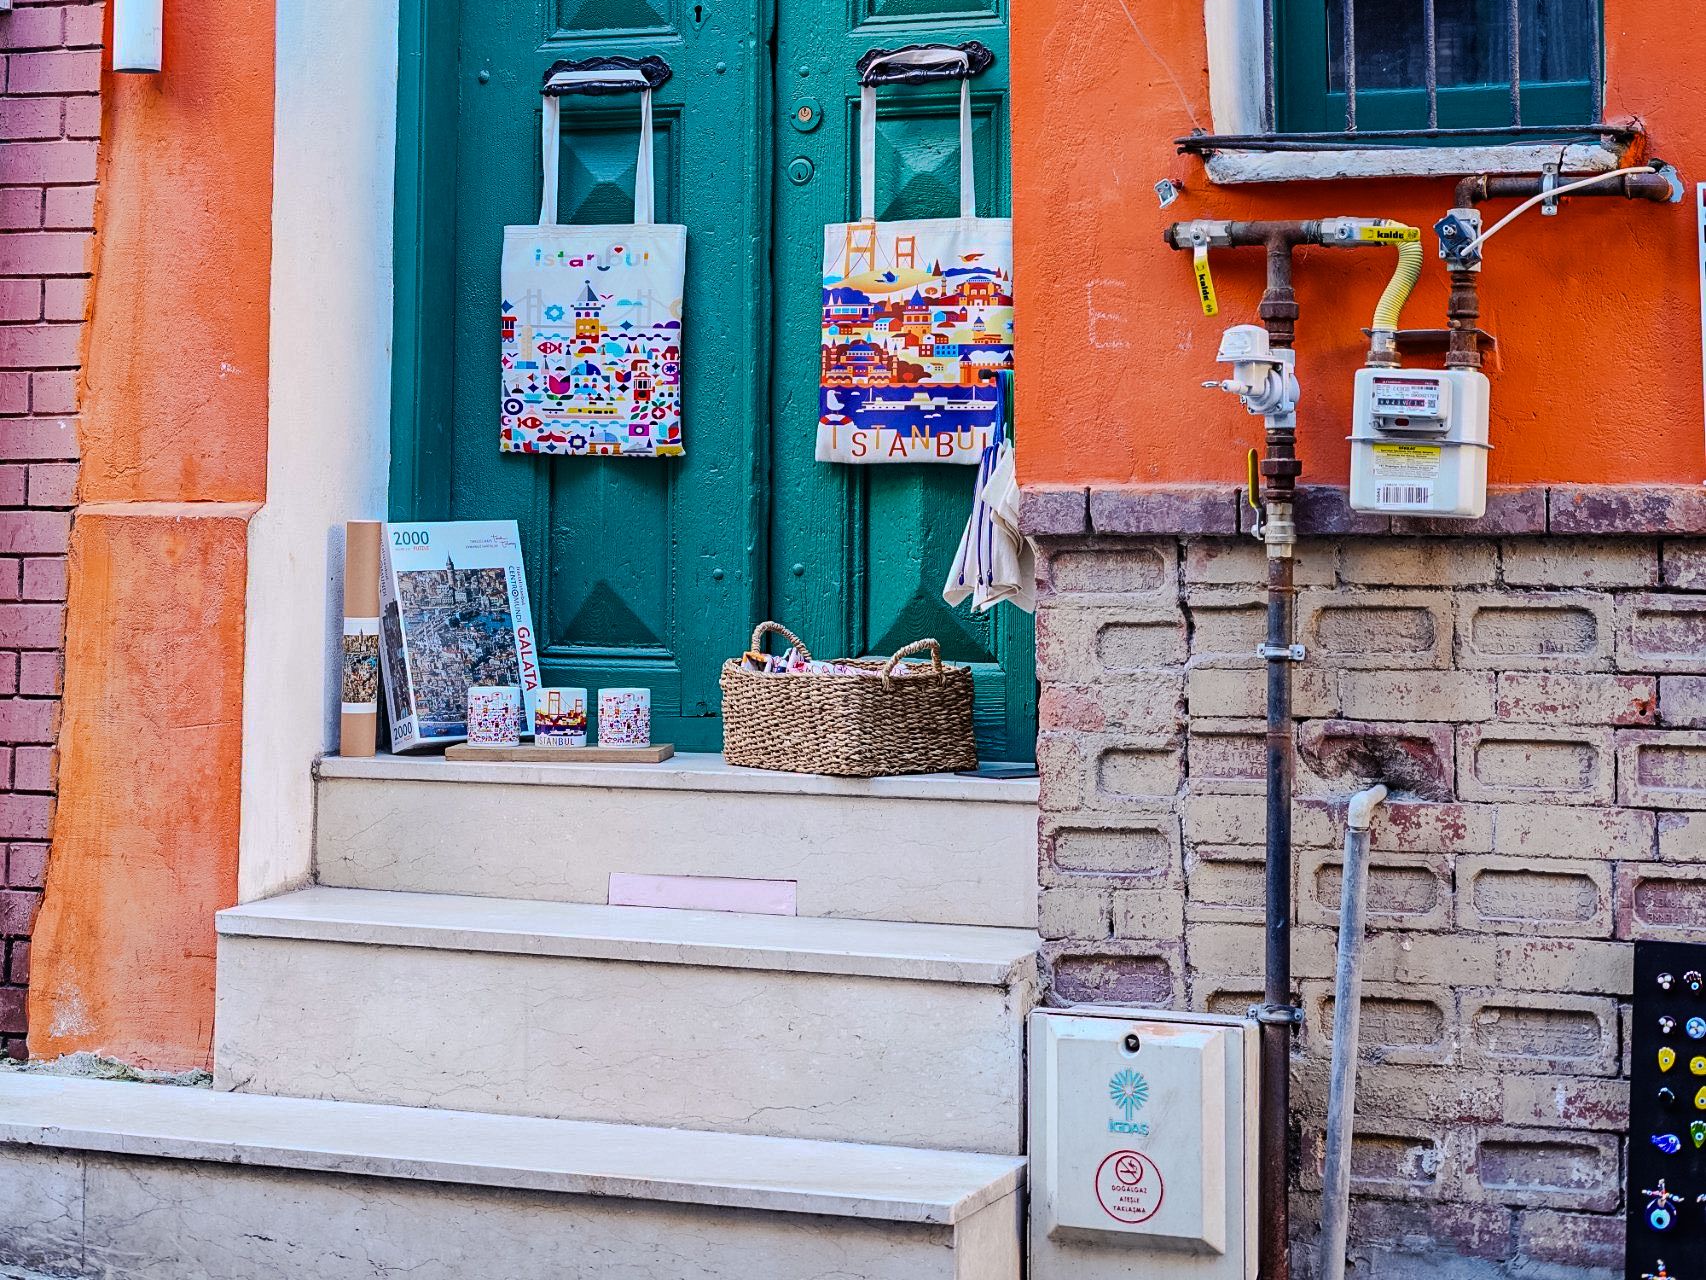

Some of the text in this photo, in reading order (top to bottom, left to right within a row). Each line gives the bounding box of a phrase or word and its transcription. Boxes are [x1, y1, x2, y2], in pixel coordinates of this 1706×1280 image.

[393, 531, 430, 546] 2000
[508, 565, 522, 623] CENTROMUNDI
[517, 626, 538, 692] GALATA
[393, 721, 413, 741] 2000
